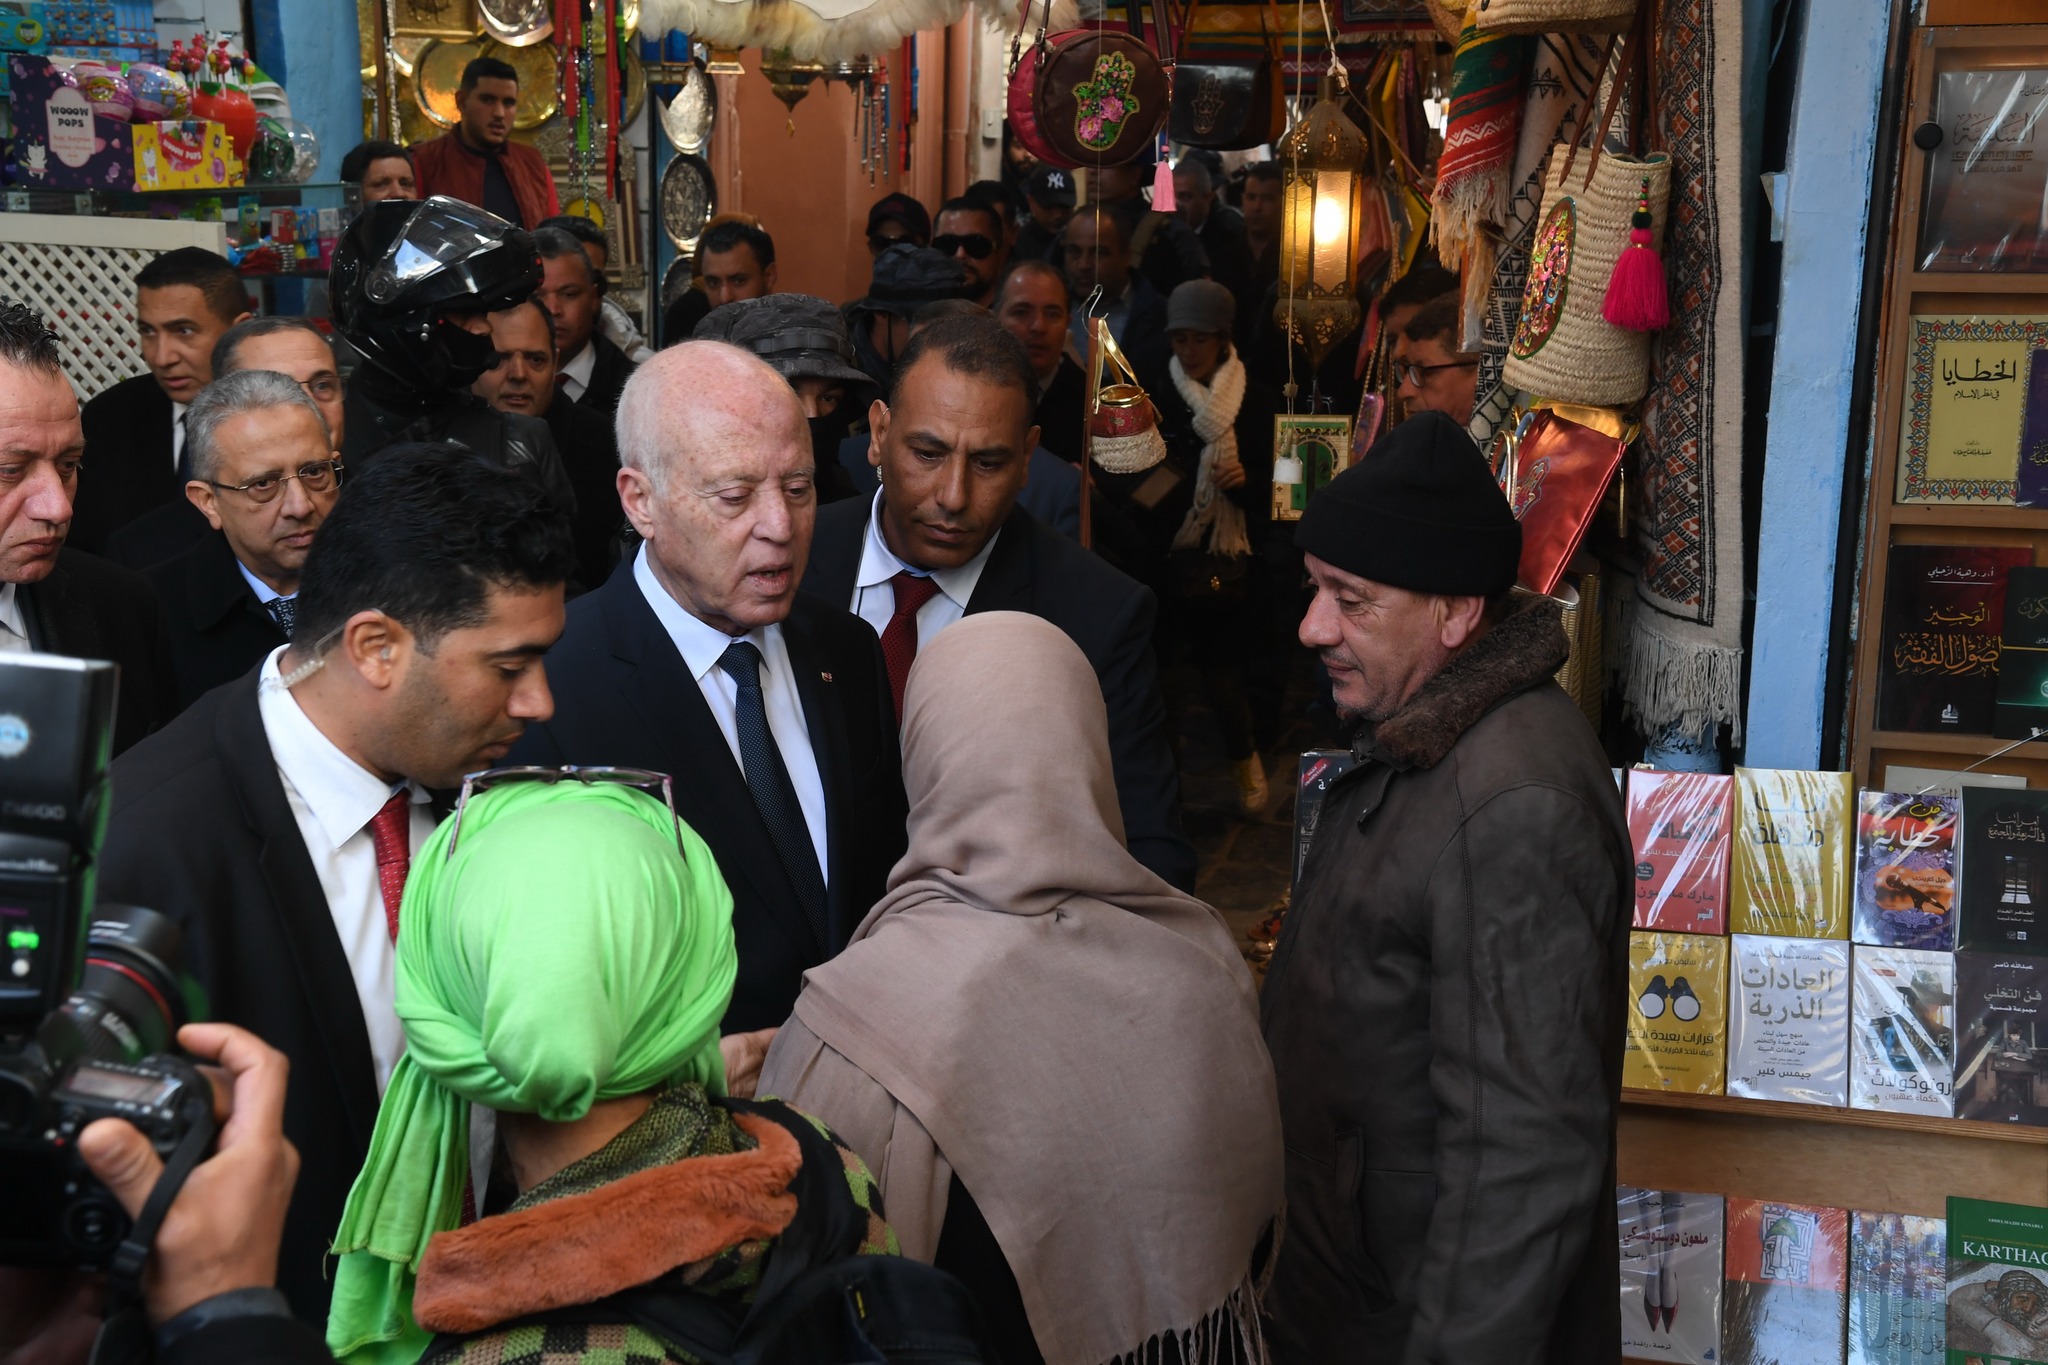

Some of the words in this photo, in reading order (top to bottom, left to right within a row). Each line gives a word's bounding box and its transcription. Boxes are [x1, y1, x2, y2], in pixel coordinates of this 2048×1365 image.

[50, 106, 89, 116] WOOOW
[58, 118, 84, 127] POPS
[1047, 172, 1065, 189] NY
[1942, 357, 2016, 385] الخطايا
[1991, 388, 2000, 401] في
[1909, 801, 1941, 817] فن
[1687, 890, 1715, 904] مارك
[1741, 967, 1833, 992] العادات
[1749, 993, 1822, 1025] الذرية
[1650, 1029, 1682, 1044] بعيدة
[1683, 1031, 1714, 1046] قرارات
[1756, 1067, 1777, 1078] كلير
[1778, 1070, 1810, 1082] جيمس
[1681, 1231, 1708, 1248] ملعون
